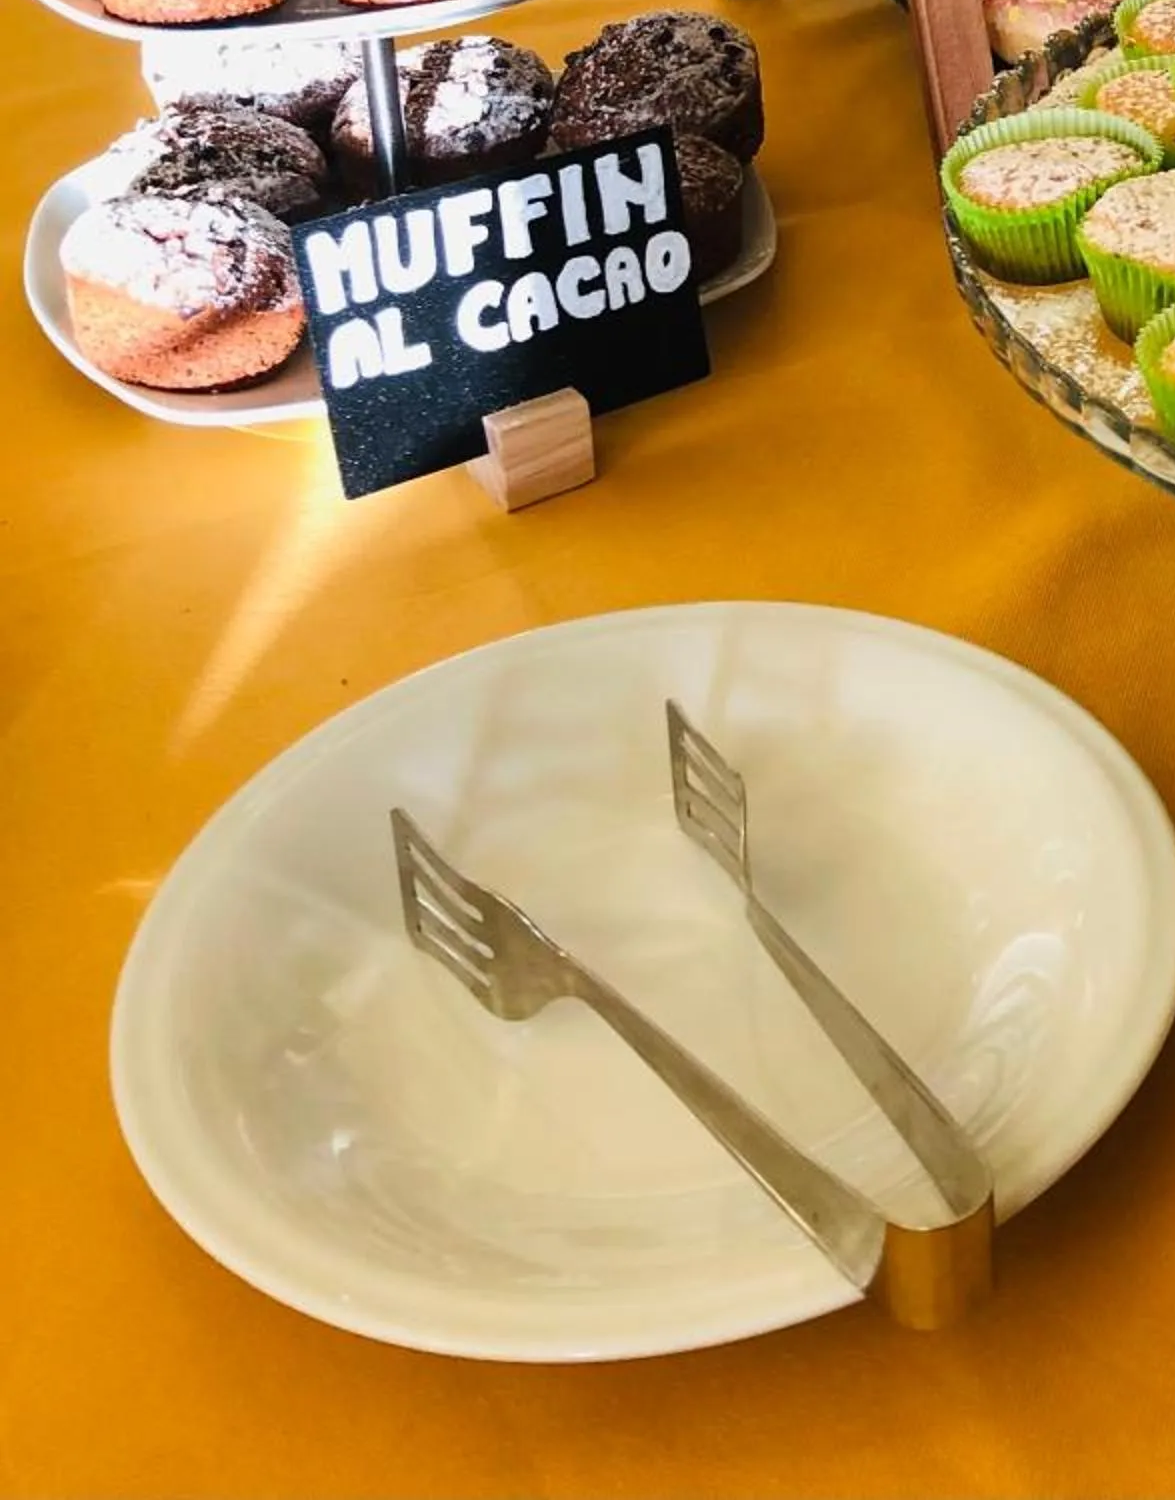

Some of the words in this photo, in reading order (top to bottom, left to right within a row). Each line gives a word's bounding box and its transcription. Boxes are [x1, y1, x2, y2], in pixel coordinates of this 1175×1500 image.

[304, 143, 667, 316] MUFFIN
[327, 306, 433, 390] AL
[455, 231, 691, 353] CACAO
